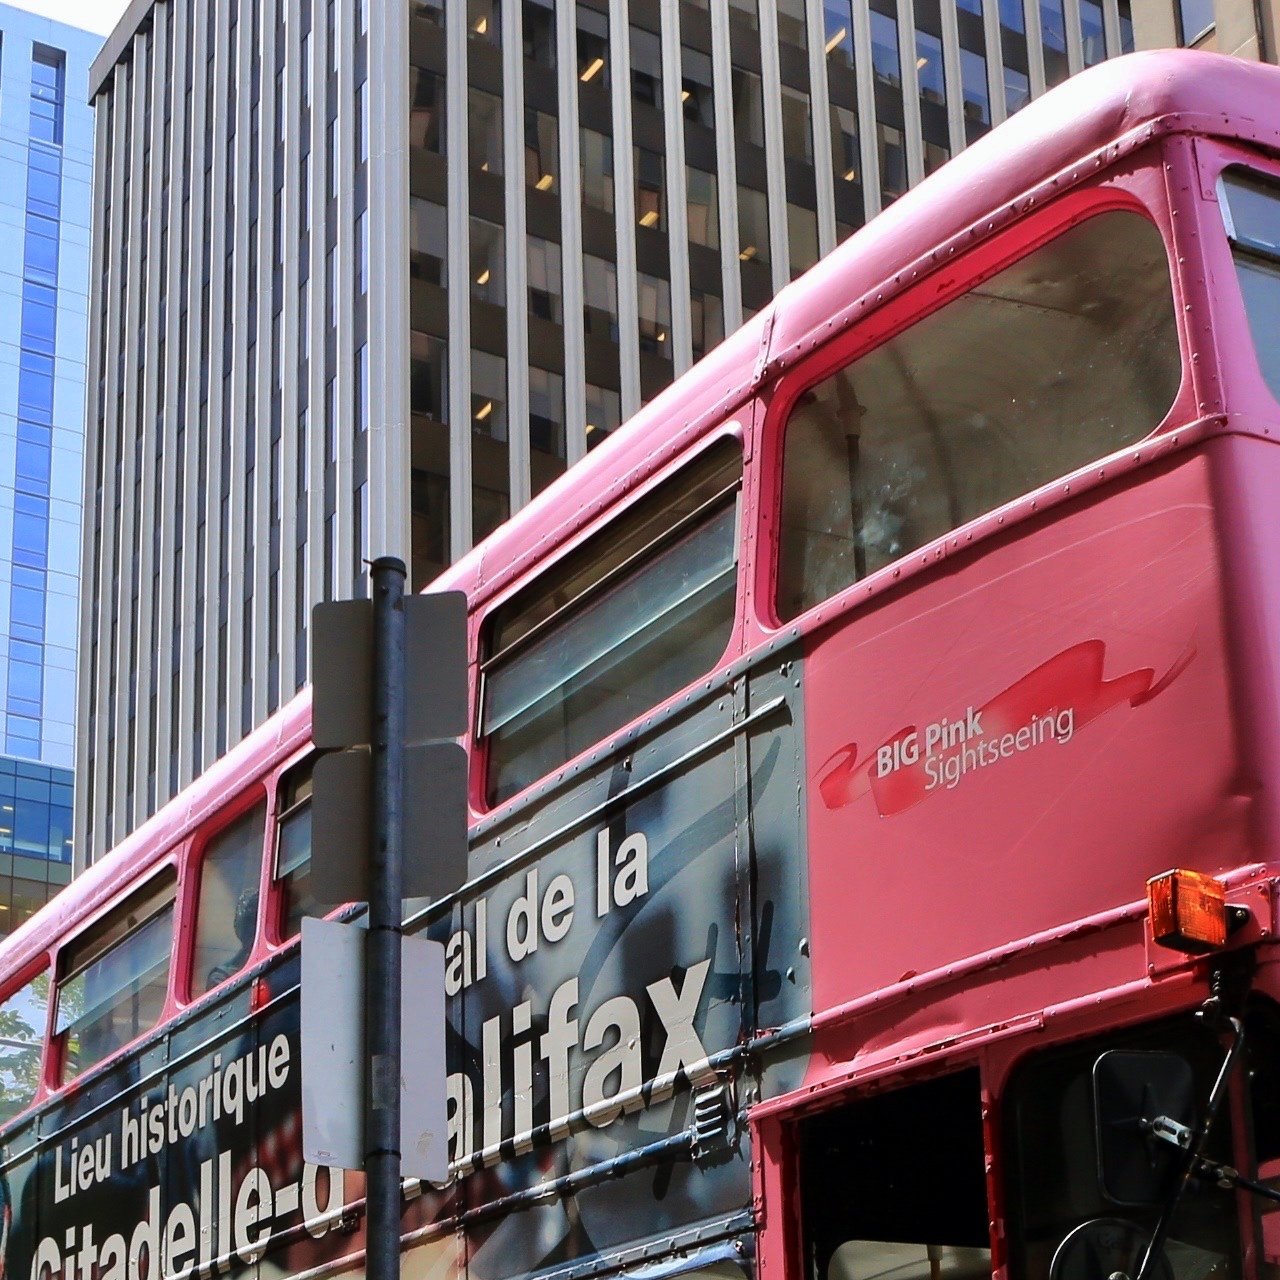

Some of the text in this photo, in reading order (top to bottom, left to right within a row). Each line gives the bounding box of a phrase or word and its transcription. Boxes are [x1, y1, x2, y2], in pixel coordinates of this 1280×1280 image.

[877, 706, 984, 778] BIG Pink
[924, 707, 1074, 791] Sightseeing
[54, 1130, 112, 1203] Lieu
[121, 1033, 291, 1171] historique
[506, 868, 575, 963] de
[597, 826, 649, 918] la
